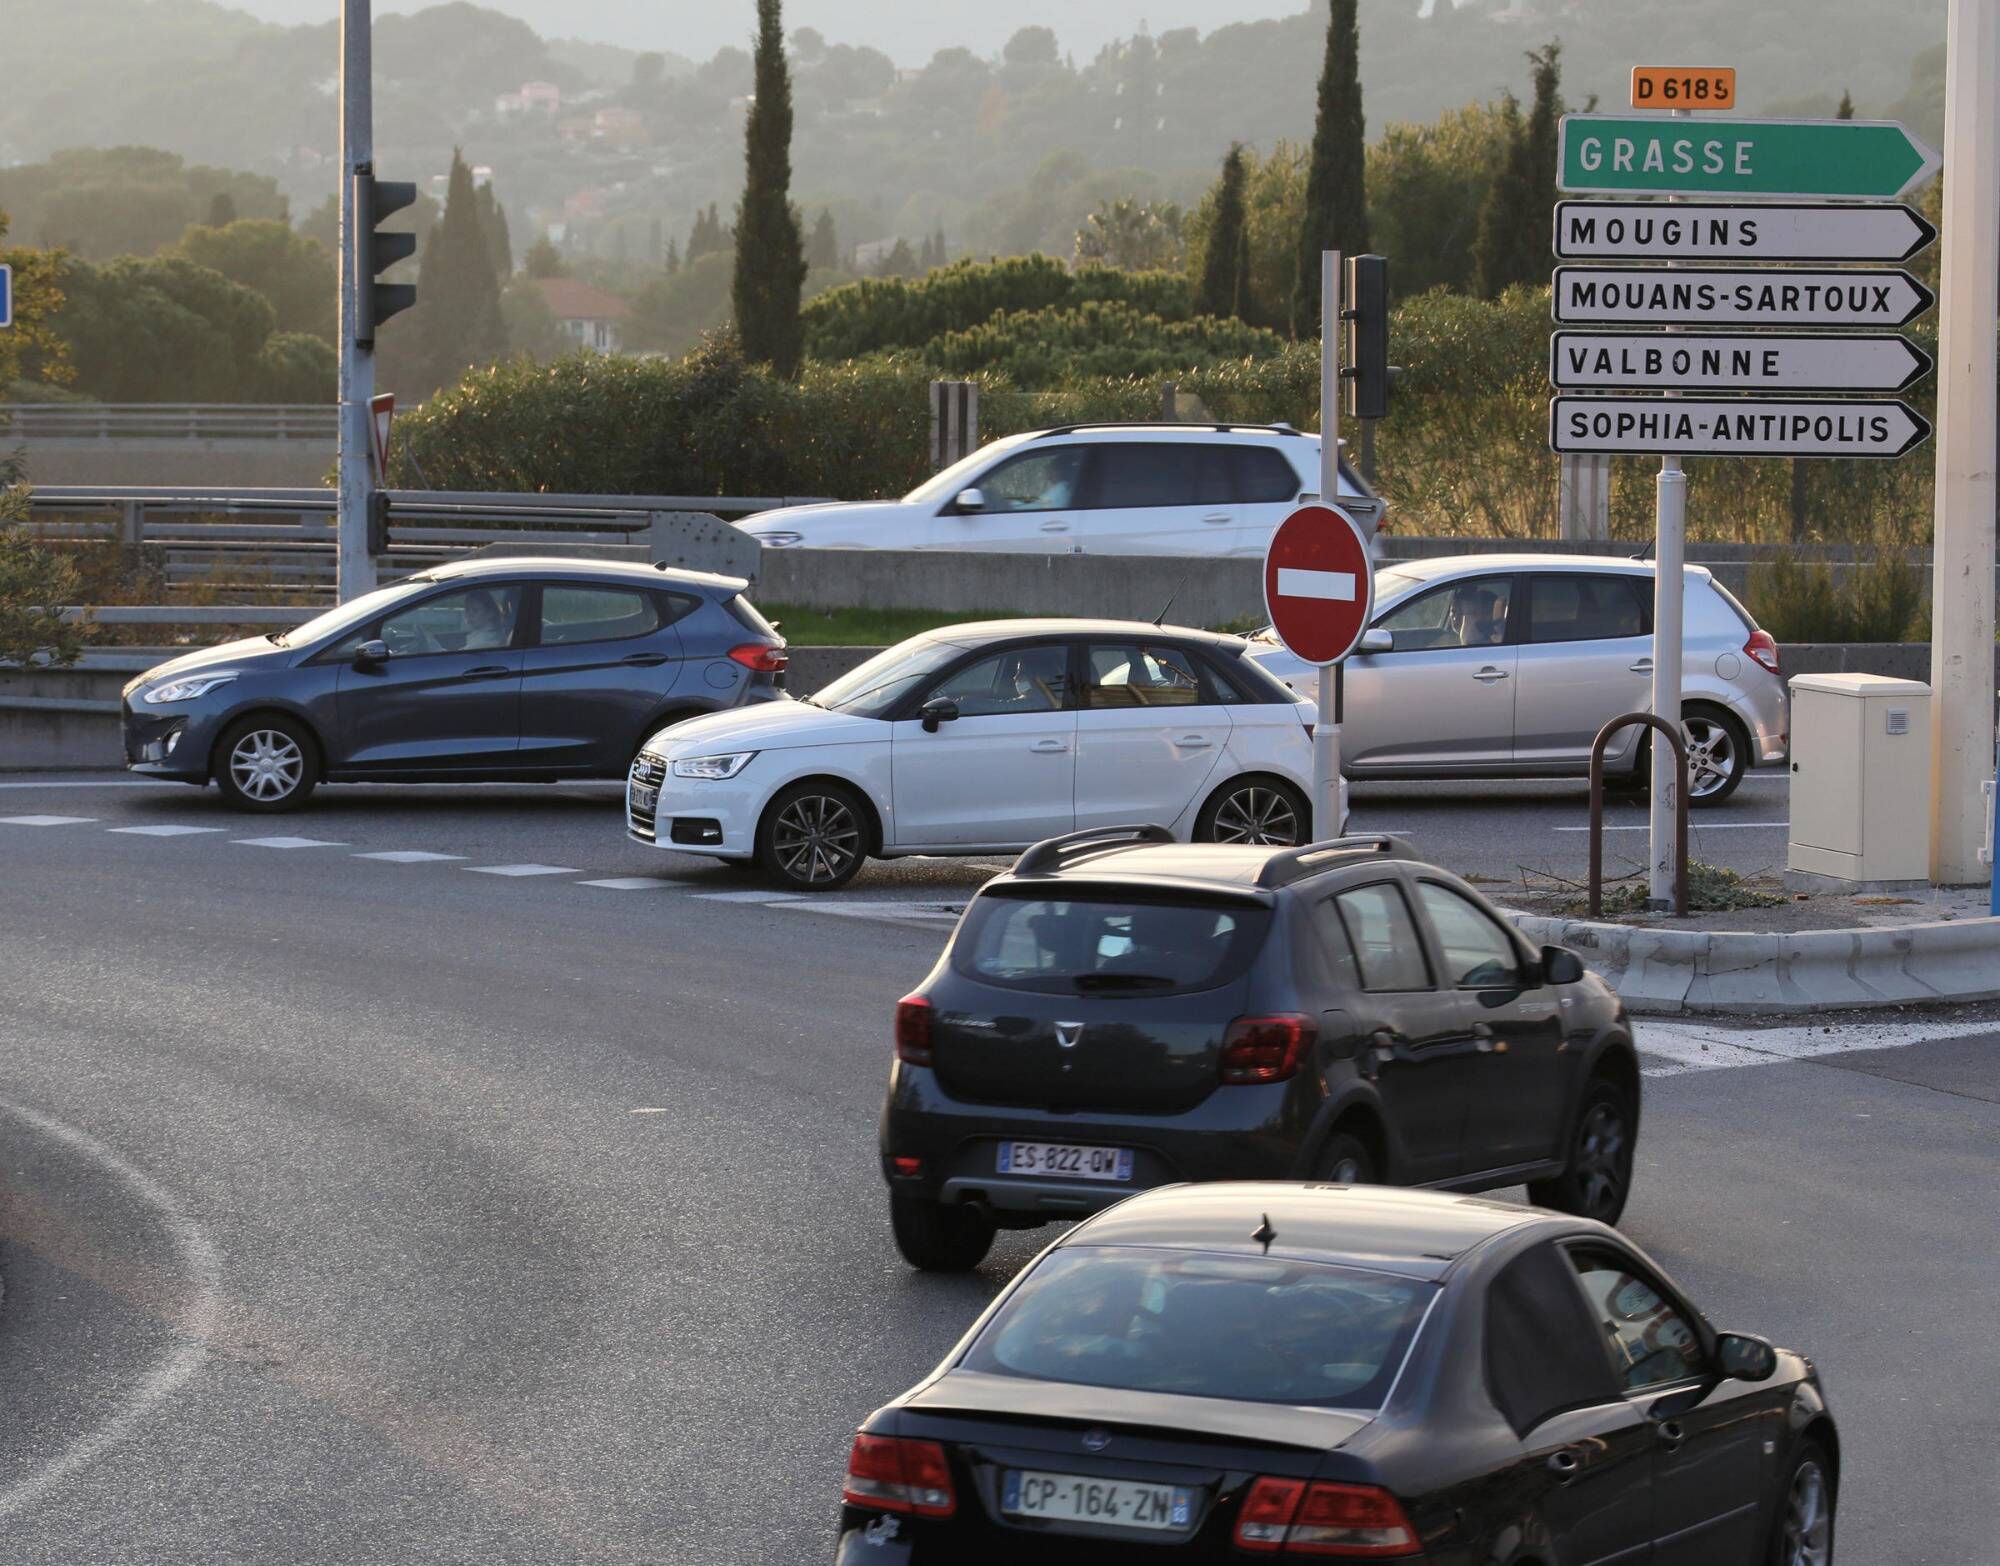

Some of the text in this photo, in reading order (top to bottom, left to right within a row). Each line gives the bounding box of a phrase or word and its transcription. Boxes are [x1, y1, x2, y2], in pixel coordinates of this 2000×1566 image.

[1638, 77, 1729, 100] D 6185
[1580, 137, 1754, 175] GRASSE
[1570, 217, 1758, 247] MOUGINS
[1571, 282, 1891, 313] MOUANS-SARTOUX
[1568, 347, 1780, 377] VALBONNE
[1569, 412, 1889, 443] SOPHIA-ANTIPOLIS
[1012, 1144, 1116, 1173] ES-822-QW
[1022, 1478, 1170, 1523] CP-164-ZN
